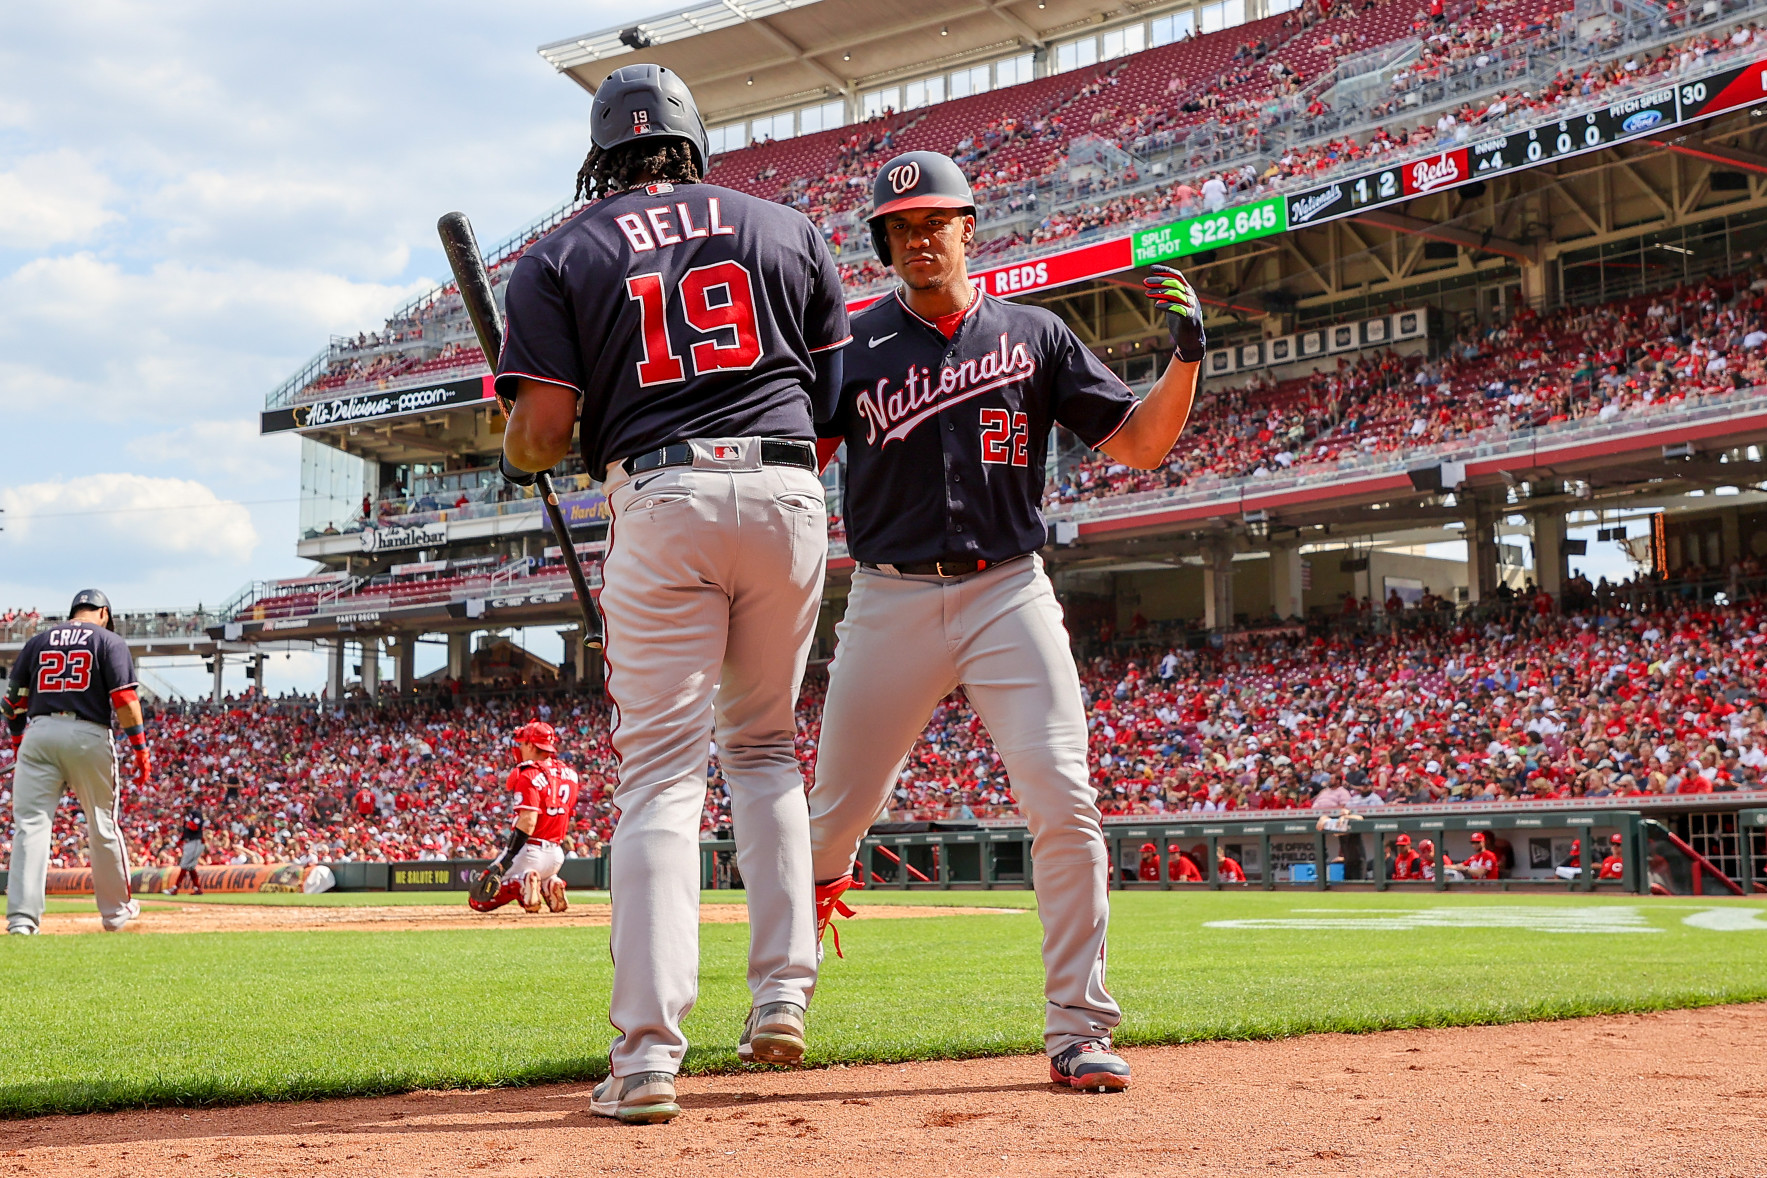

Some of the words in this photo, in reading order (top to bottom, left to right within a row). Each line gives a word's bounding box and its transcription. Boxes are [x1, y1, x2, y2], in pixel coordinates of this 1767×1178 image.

[1609, 99, 1640, 118] PITCH
[1640, 89, 1673, 110] SPEED
[1682, 82, 1707, 106] 30
[632, 110, 648, 124] 19
[1474, 137, 1508, 156] INNING
[1527, 141, 1542, 161] 0
[1556, 132, 1571, 153] 0
[1584, 125, 1600, 146] 0
[1490, 151, 1503, 170] 4
[1291, 183, 1343, 222] Nationals
[1354, 178, 1369, 203] 1
[1379, 171, 1396, 197] 2
[1411, 152, 1459, 191] Reds
[614, 197, 736, 253] BELL
[1140, 229, 1172, 247] SPLIT
[1189, 204, 1277, 247] $22,645
[1136, 246, 1157, 261] THE
[1158, 240, 1182, 256] POT
[995, 262, 1048, 294] REDS
[625, 259, 764, 388] 19
[856, 332, 1036, 450] Nationals
[305, 401, 331, 426] Al's
[331, 396, 391, 423] Delicious
[398, 388, 447, 412] popcorn
[979, 407, 1029, 467] 22
[570, 501, 598, 521] Hard
[378, 530, 445, 548] handlebar
[49, 629, 94, 646] CRUZ
[37, 649, 94, 694] 23
[395, 870, 407, 884] WE
[407, 870, 433, 884] SALUTE
[434, 870, 450, 884] YOU
